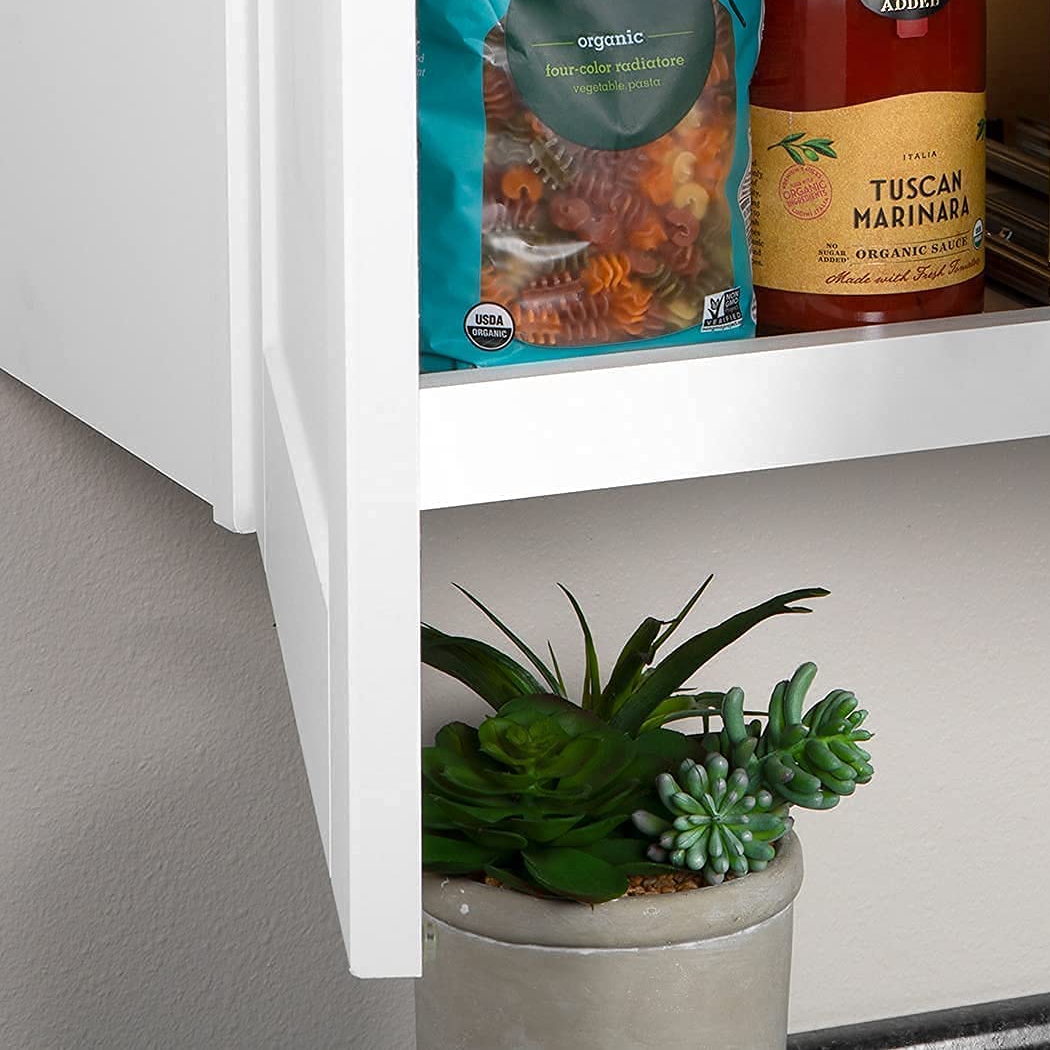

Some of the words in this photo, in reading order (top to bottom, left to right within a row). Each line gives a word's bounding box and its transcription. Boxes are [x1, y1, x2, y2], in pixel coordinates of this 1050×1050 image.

[577, 30, 644, 51] organic
[545, 60, 612, 77] four-color
[615, 55, 685, 72] radiatore
[572, 80, 624, 94] vegetable
[628, 77, 661, 92] pasta
[903, 150, 937, 161] ITALIA
[869, 169, 962, 202] TUSCAN
[853, 195, 969, 229] MARINARA
[855, 245, 927, 259] ORGANIC
[931, 236, 968, 254] SAUCE
[825, 270, 871, 284] Made
[873, 270, 911, 283] with
[913, 264, 947, 281] Fresh
[475, 313, 504, 326] USDA
[472, 328, 508, 338] ORGANIC
